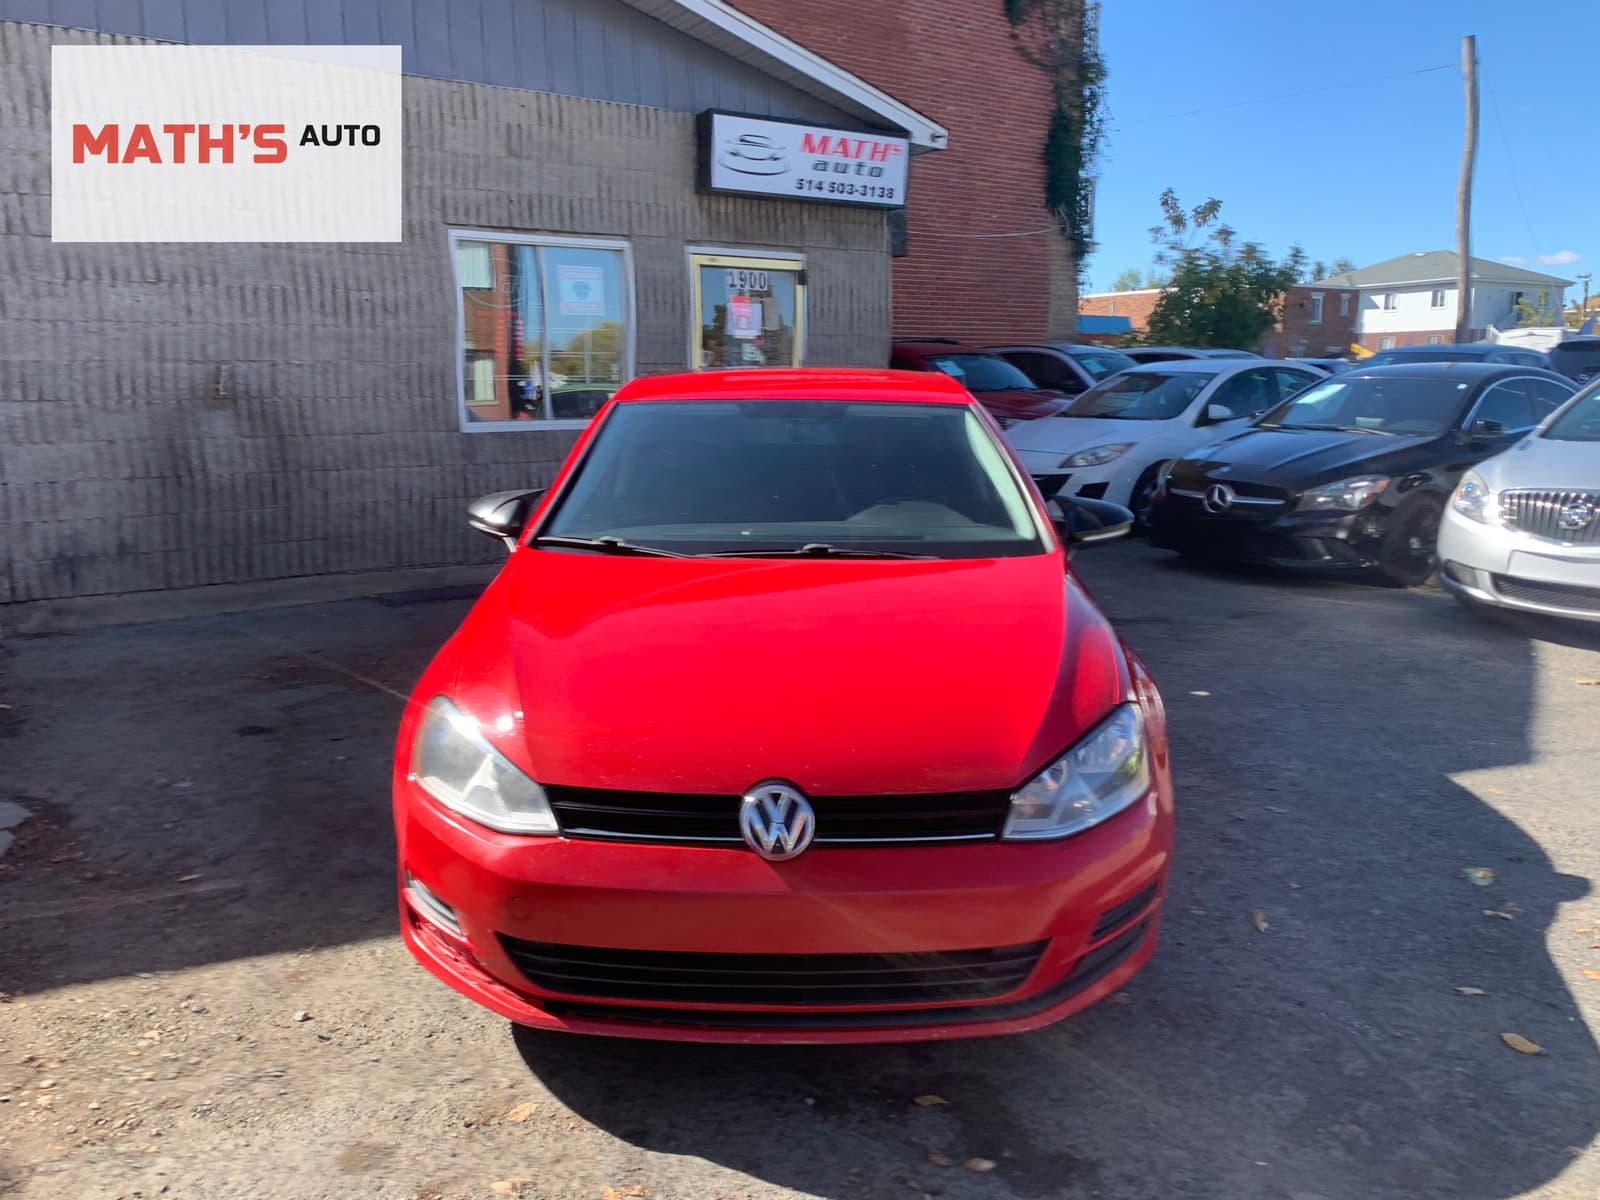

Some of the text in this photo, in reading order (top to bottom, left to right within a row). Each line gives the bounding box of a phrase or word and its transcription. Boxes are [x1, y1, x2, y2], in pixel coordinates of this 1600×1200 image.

[812, 160, 885, 177] auto
[796, 178, 894, 199] 514 503-3138
[729, 271, 767, 289] 1900
